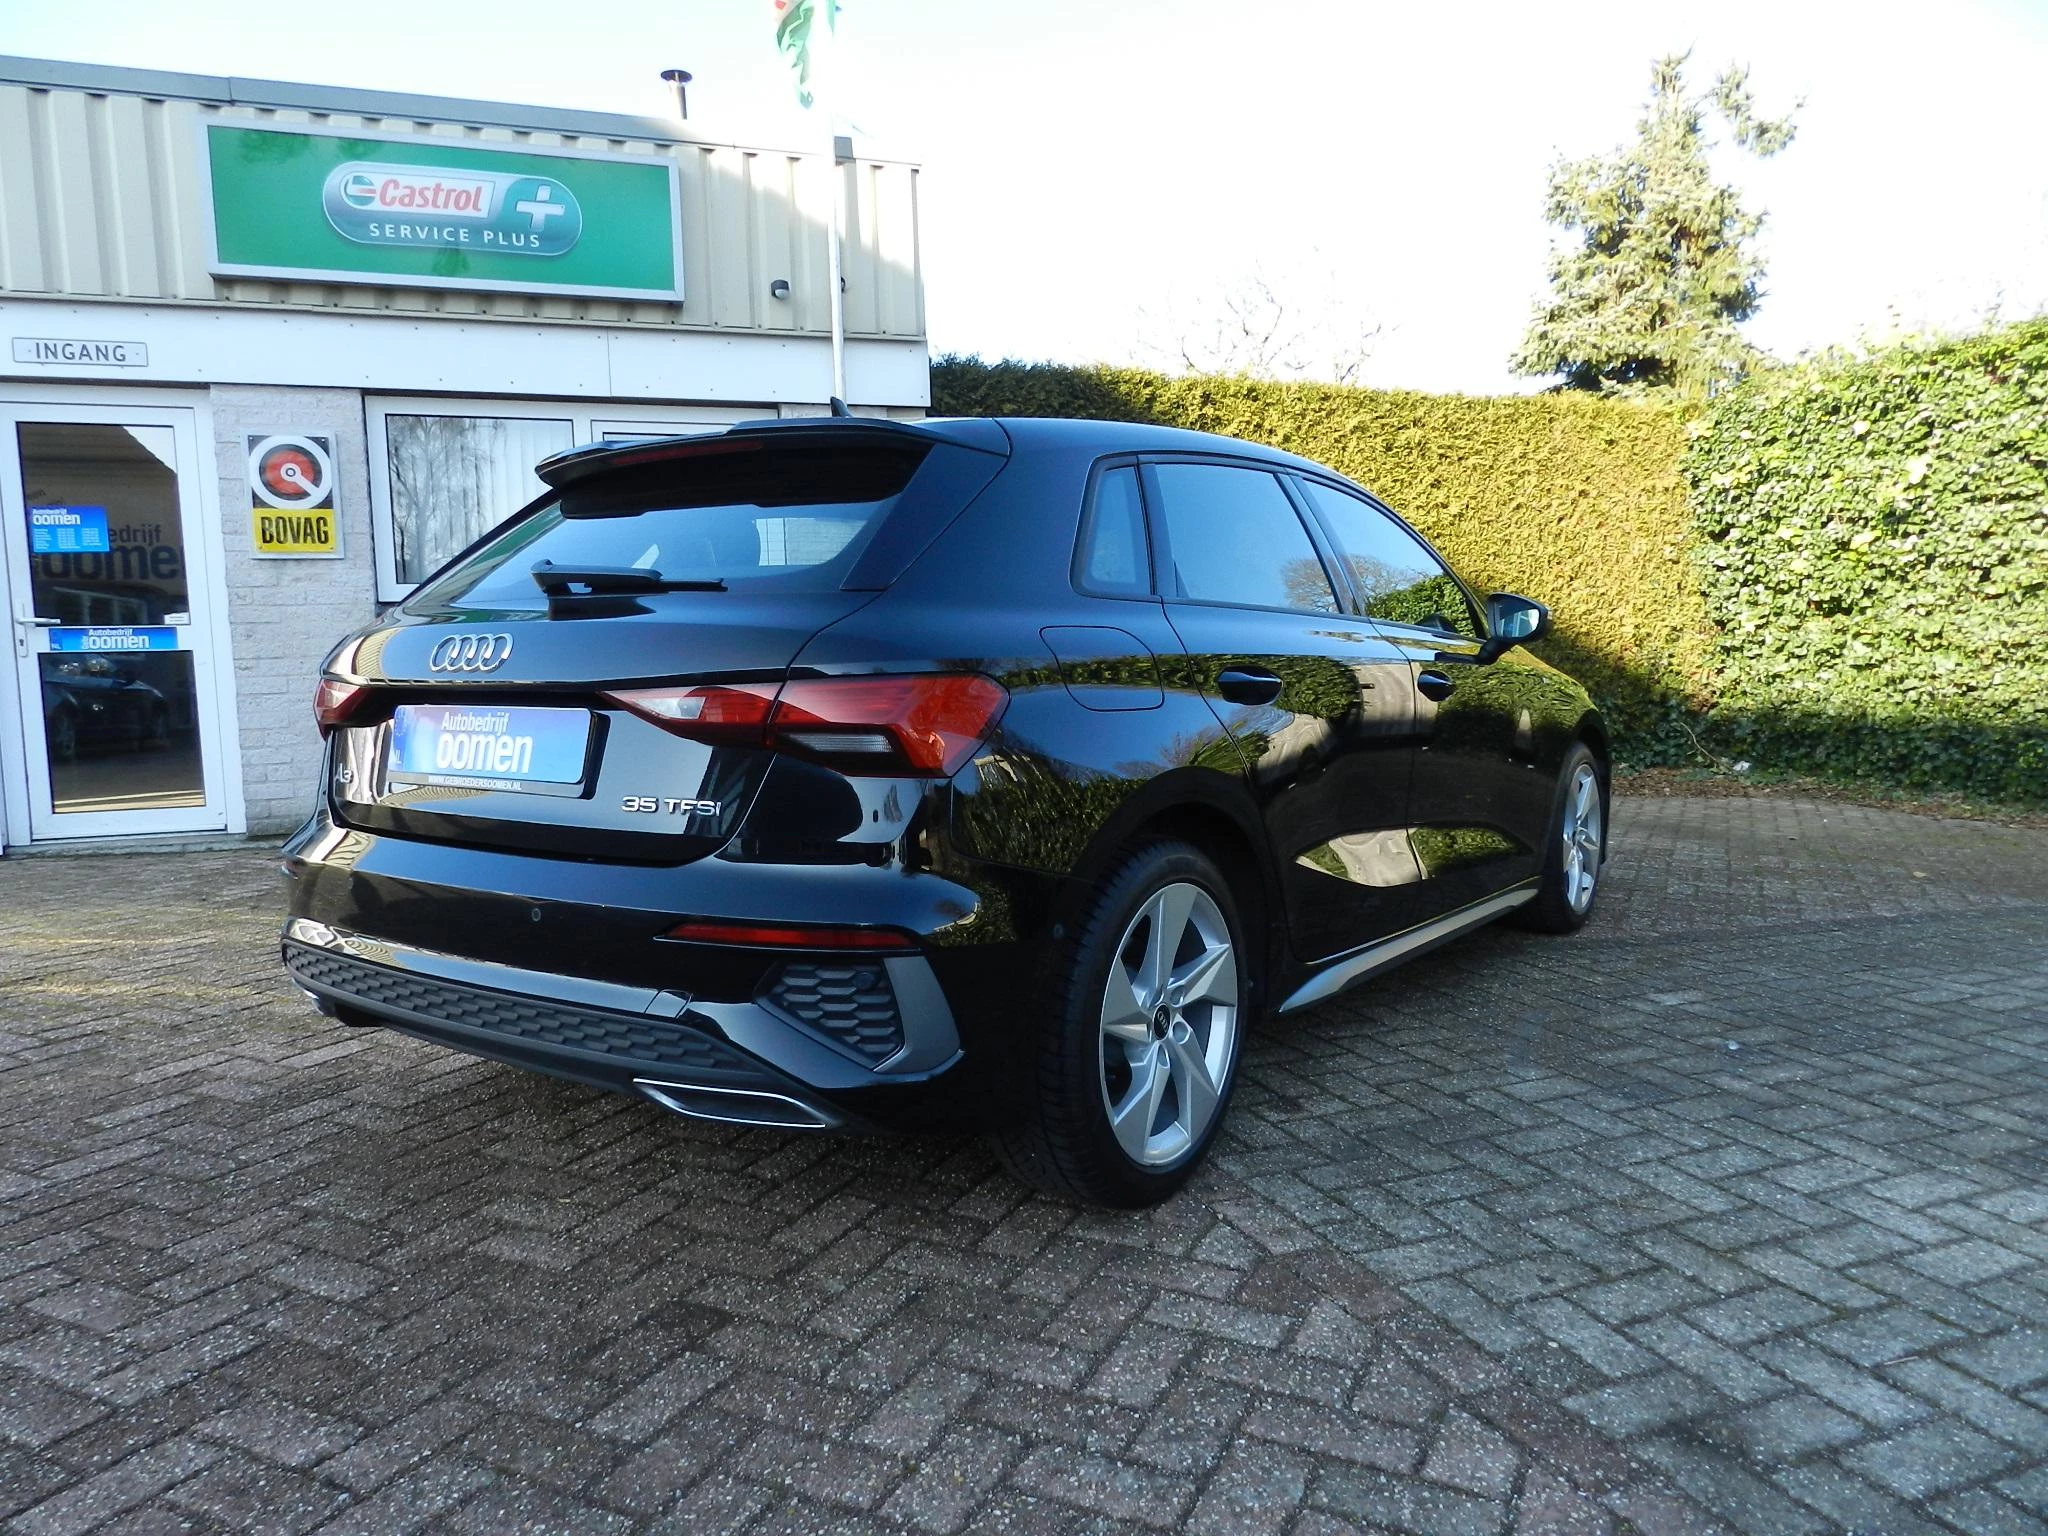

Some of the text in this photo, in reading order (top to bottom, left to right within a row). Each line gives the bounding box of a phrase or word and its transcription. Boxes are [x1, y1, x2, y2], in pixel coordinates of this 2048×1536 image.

[379, 179, 483, 213] Castrol
[368, 222, 541, 248] SERVICE PLUS
[35, 342, 127, 362] INGANG
[33, 514, 81, 525] oomen
[261, 516, 330, 544] BOVAG
[109, 524, 161, 545] edrijf
[42, 545, 181, 580] oome
[89, 635, 150, 649] oomen
[441, 711, 510, 736] Autobedrijf
[436, 733, 533, 774] oomen
[621, 796, 722, 817] 35 TFSI
